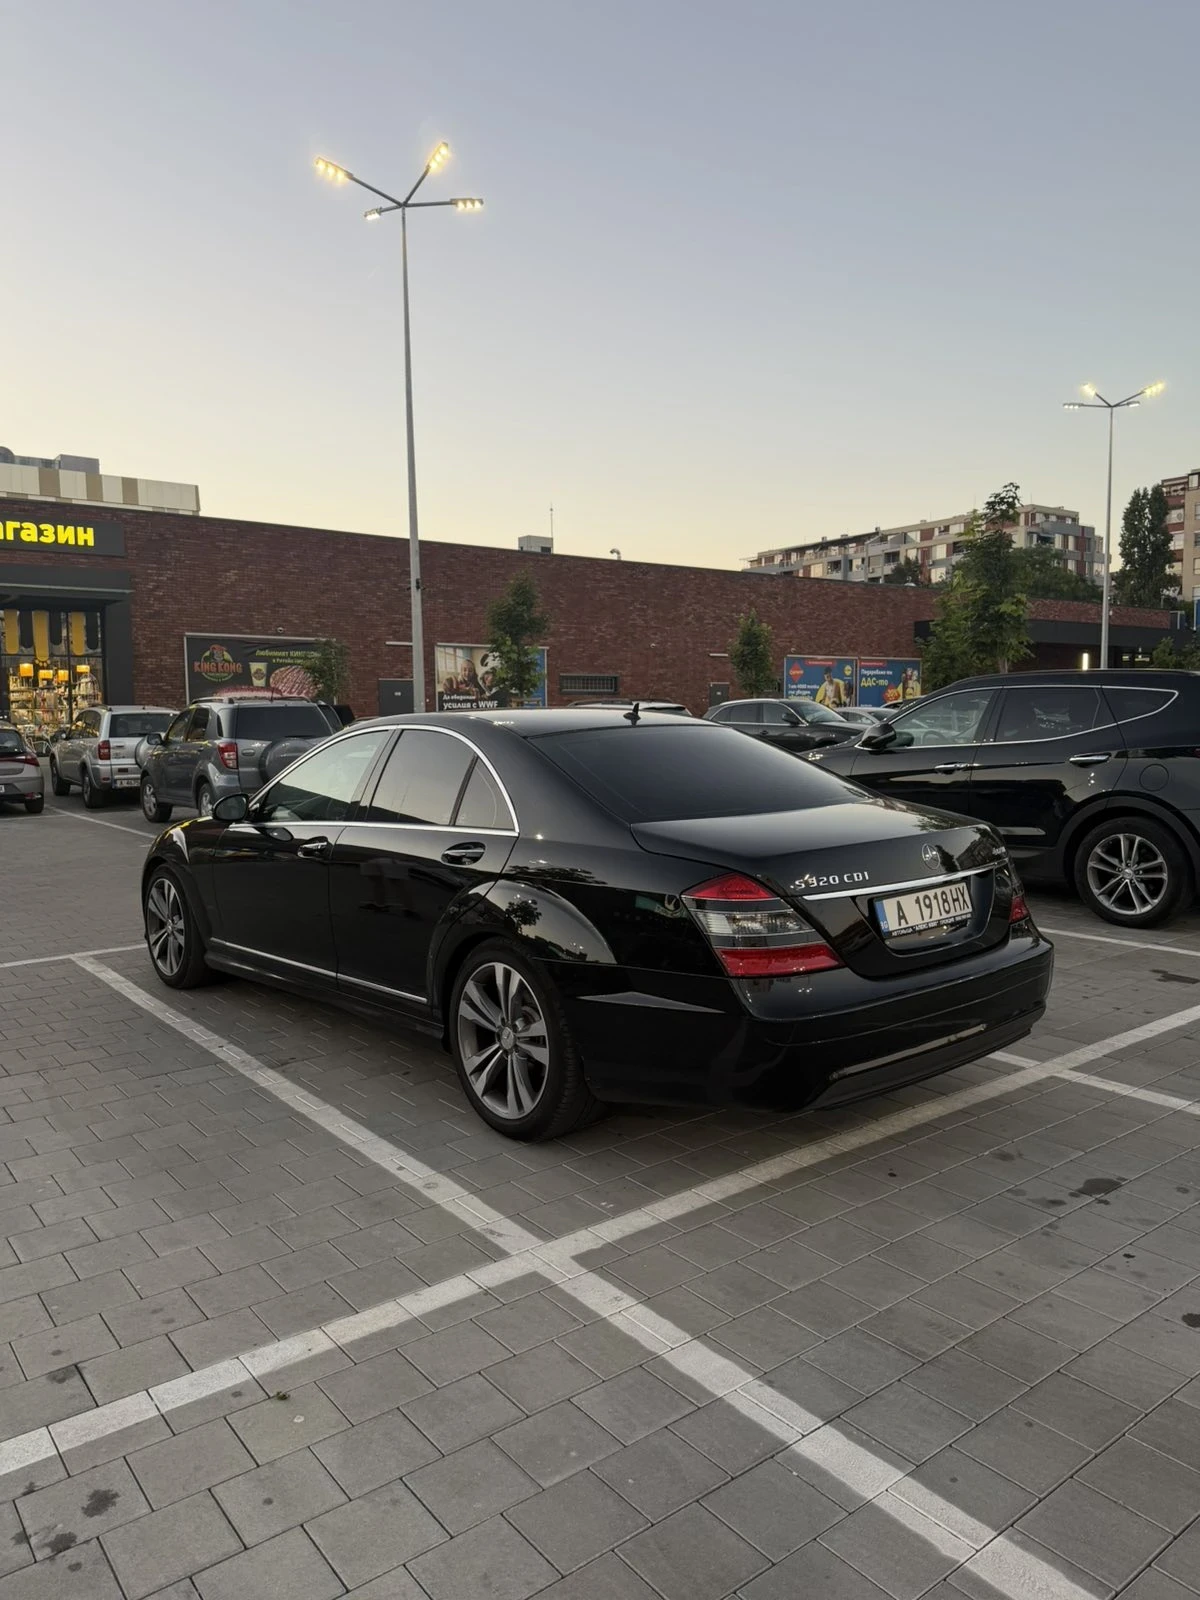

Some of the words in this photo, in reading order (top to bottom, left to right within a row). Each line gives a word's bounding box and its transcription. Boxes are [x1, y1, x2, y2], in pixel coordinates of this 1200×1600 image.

[193, 661, 217, 673] KING
[217, 662, 243, 674] KONG
[443, 702, 471, 710] усилия
[478, 700, 498, 708] WWF
[843, 871, 869, 883] CDI
